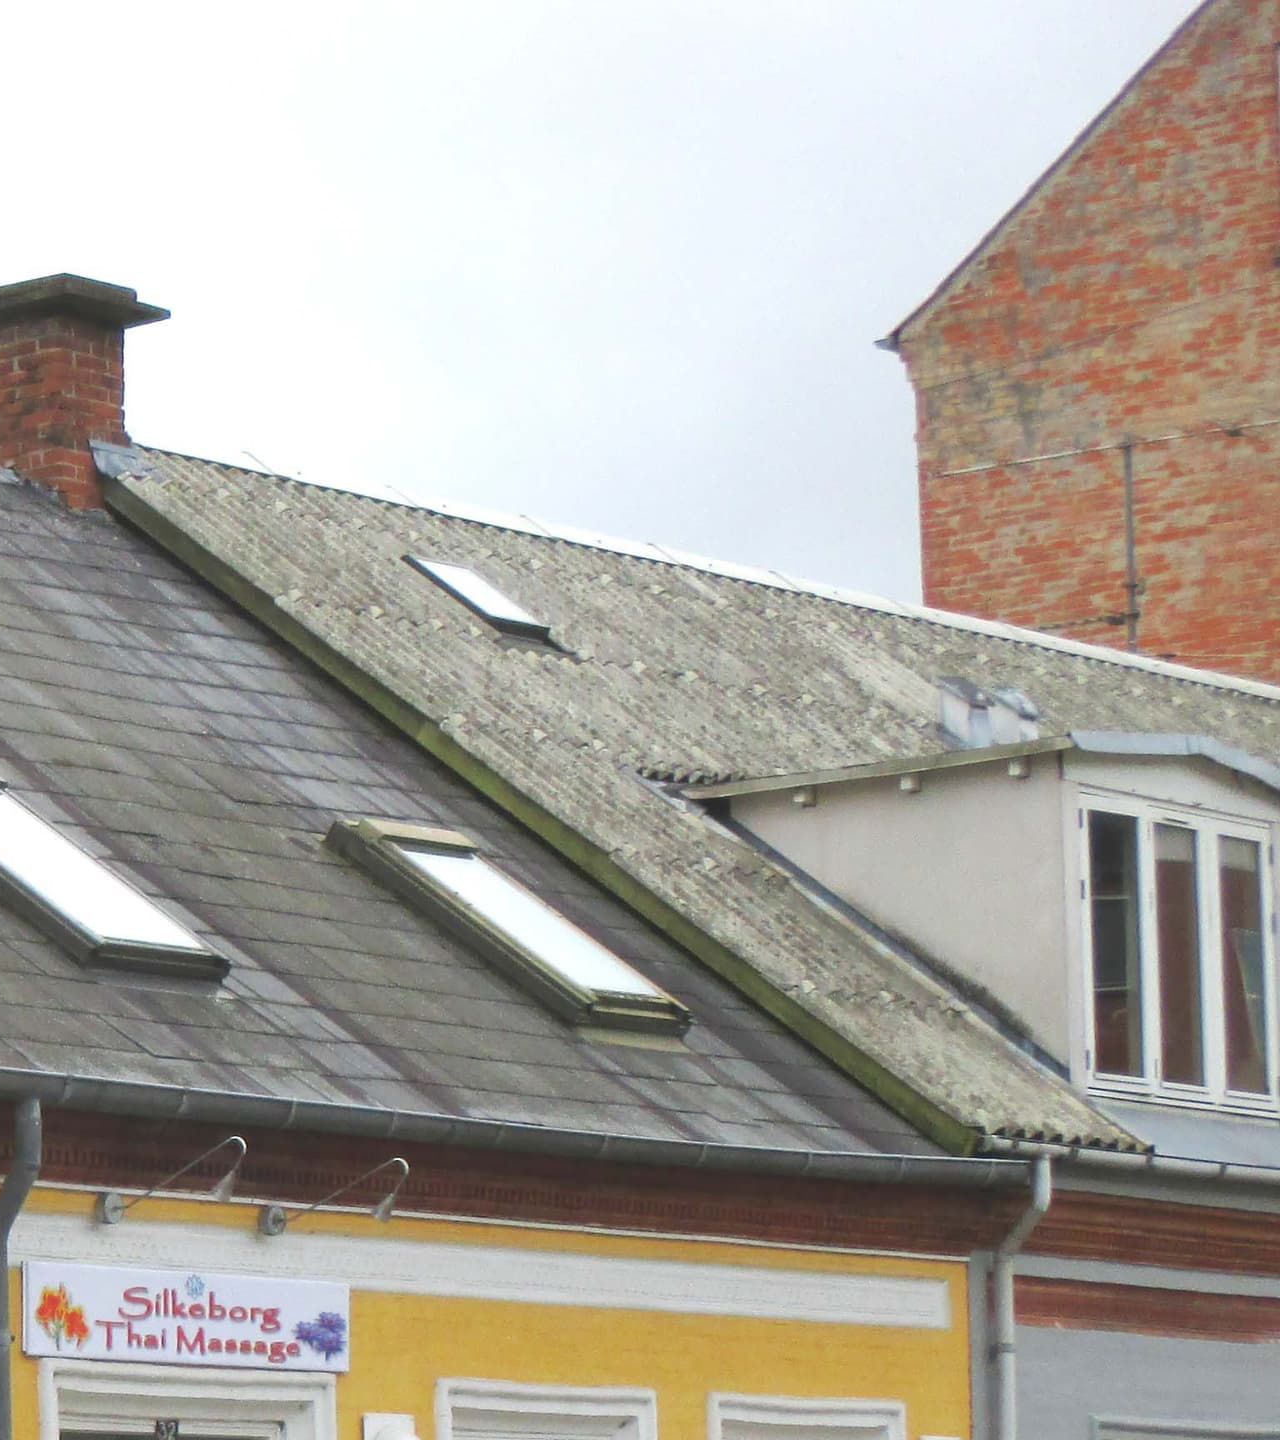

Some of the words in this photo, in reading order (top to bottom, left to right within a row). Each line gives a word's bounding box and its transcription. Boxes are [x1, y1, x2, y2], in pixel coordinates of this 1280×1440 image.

[118, 1285, 281, 1332] Silkeborg
[95, 1319, 167, 1350] Thai
[175, 1324, 301, 1363] Massage
